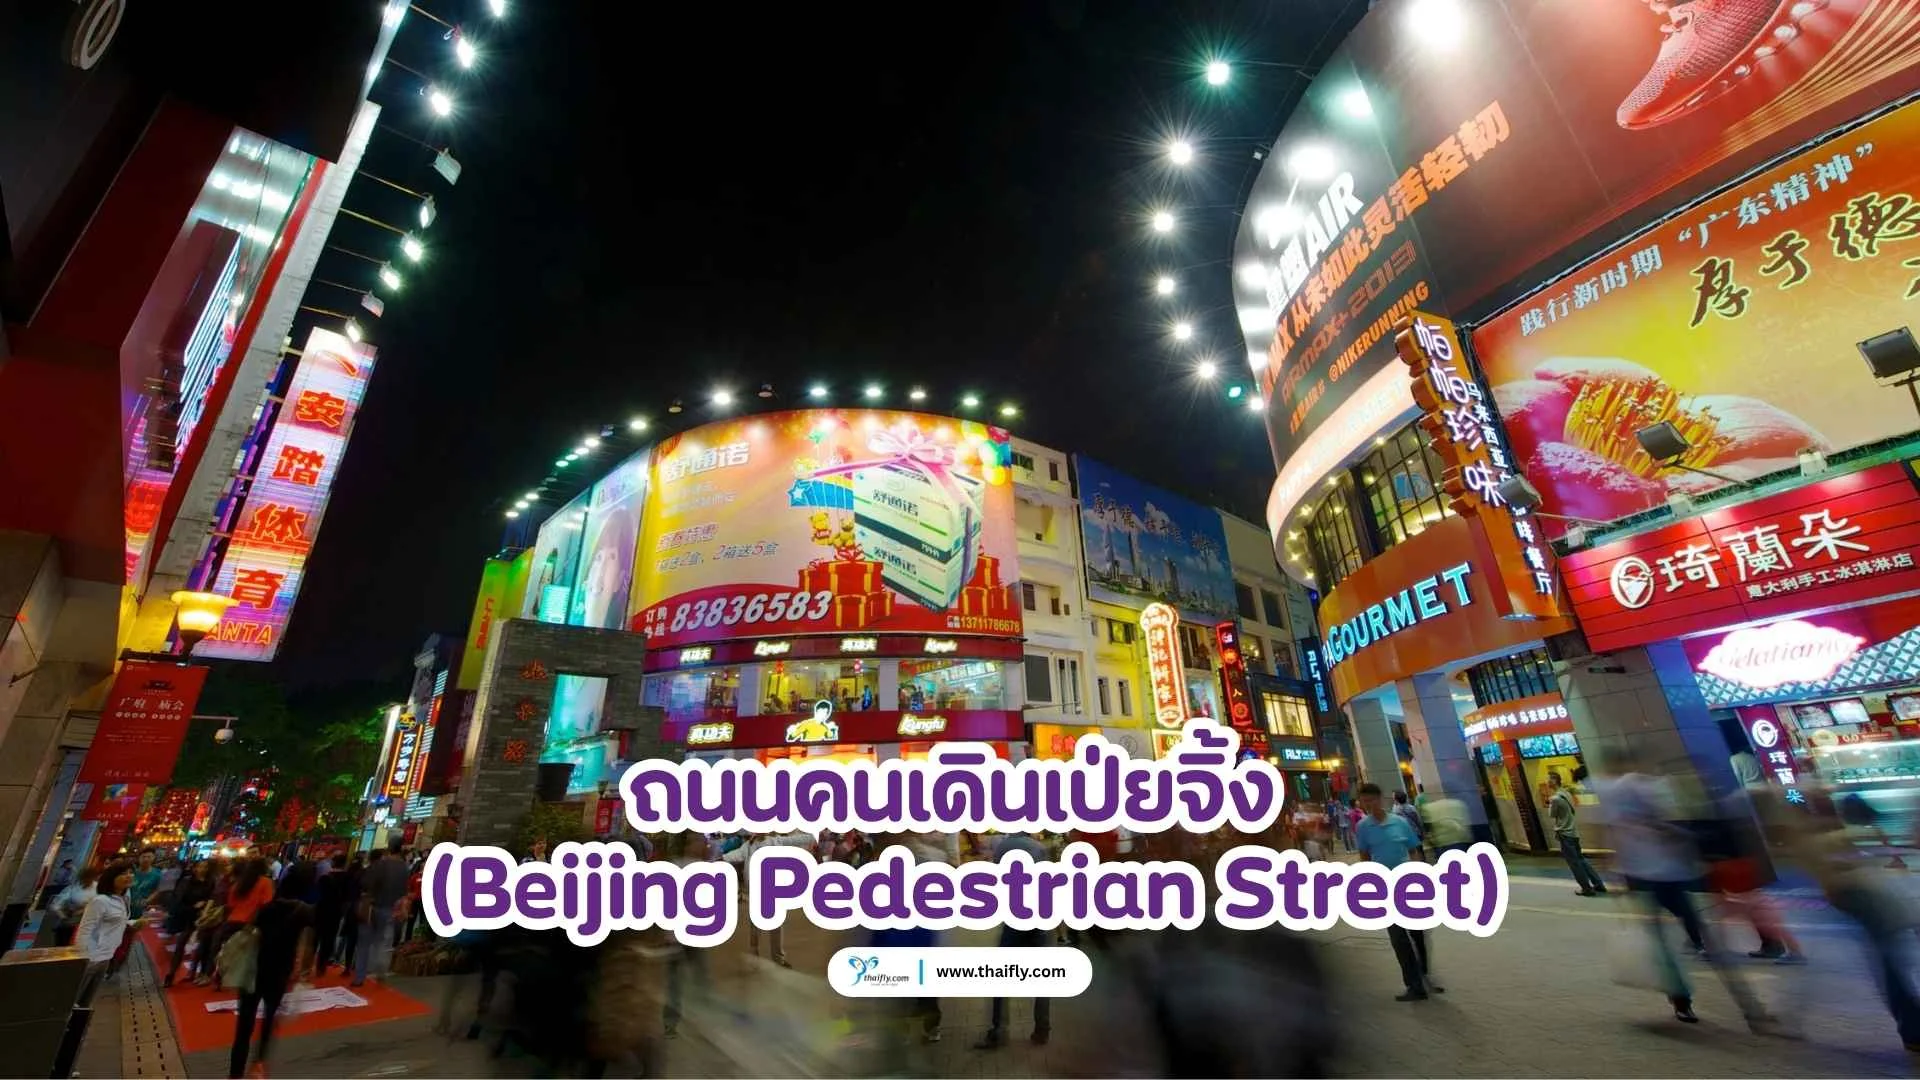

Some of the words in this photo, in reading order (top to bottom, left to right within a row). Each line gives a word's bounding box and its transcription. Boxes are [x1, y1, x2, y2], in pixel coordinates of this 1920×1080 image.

[1519, 244, 1663, 337] 践行新时期
[1679, 142, 1873, 249] “广东精神”
[1328, 279, 1430, 383] @NIKERUNNING
[230, 388, 346, 611] 安踏体育
[1466, 380, 1554, 596] 马来西亚啡餐厅
[670, 590, 832, 633] 83836583
[1746, 552, 1914, 599] 意大利手工冰淇淋店
[206, 621, 273, 646] ANTA
[688, 723, 734, 744] 真功夫
